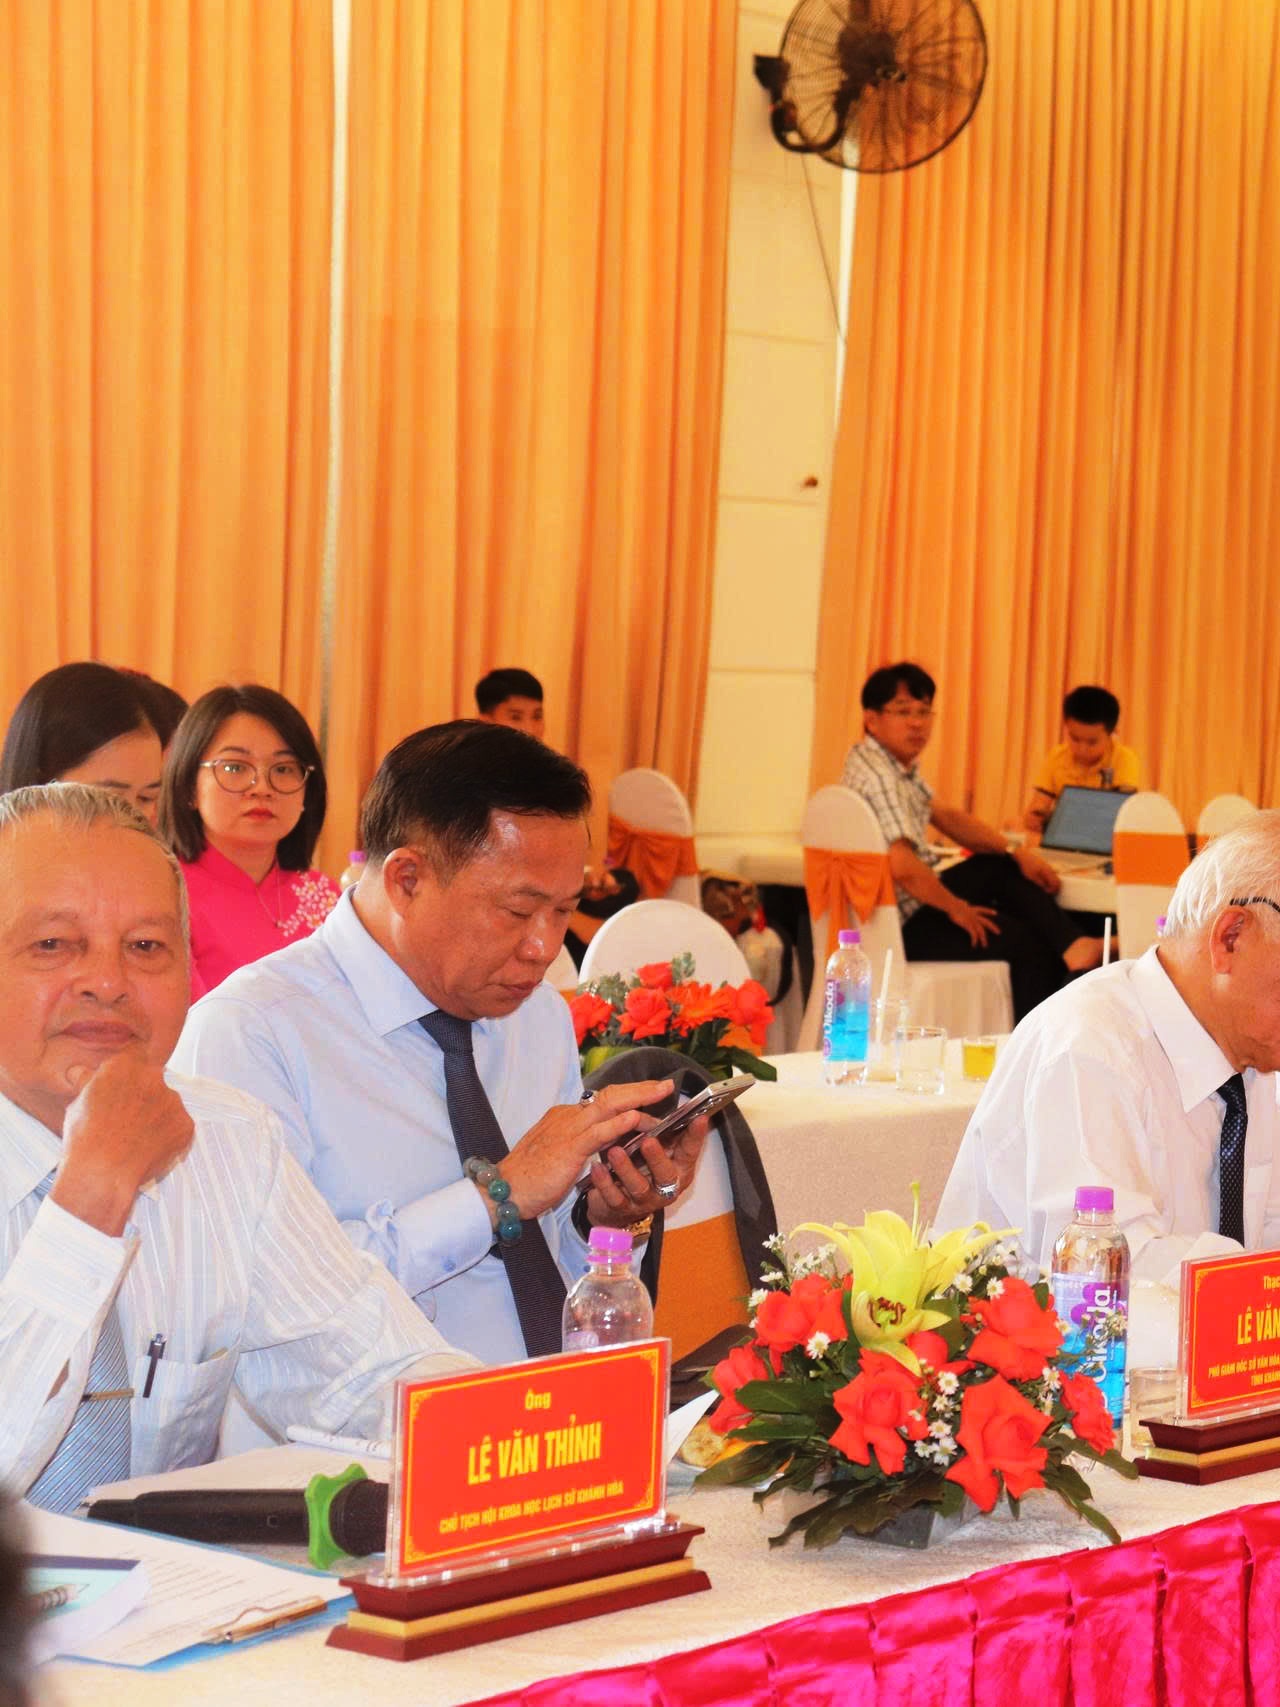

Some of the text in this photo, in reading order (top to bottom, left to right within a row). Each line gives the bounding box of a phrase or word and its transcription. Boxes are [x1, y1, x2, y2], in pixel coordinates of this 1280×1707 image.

[1263, 1275, 1280, 1292] Thạc
[1237, 1305, 1252, 1345] LÊ
[525, 1388, 552, 1410] Ông
[468, 1414, 602, 1485] LÊ VĂN THỈNH
[439, 1512, 458, 1534] CHỦ
[460, 1512, 481, 1531] TỊCH
[498, 1503, 521, 1521] KHOA
